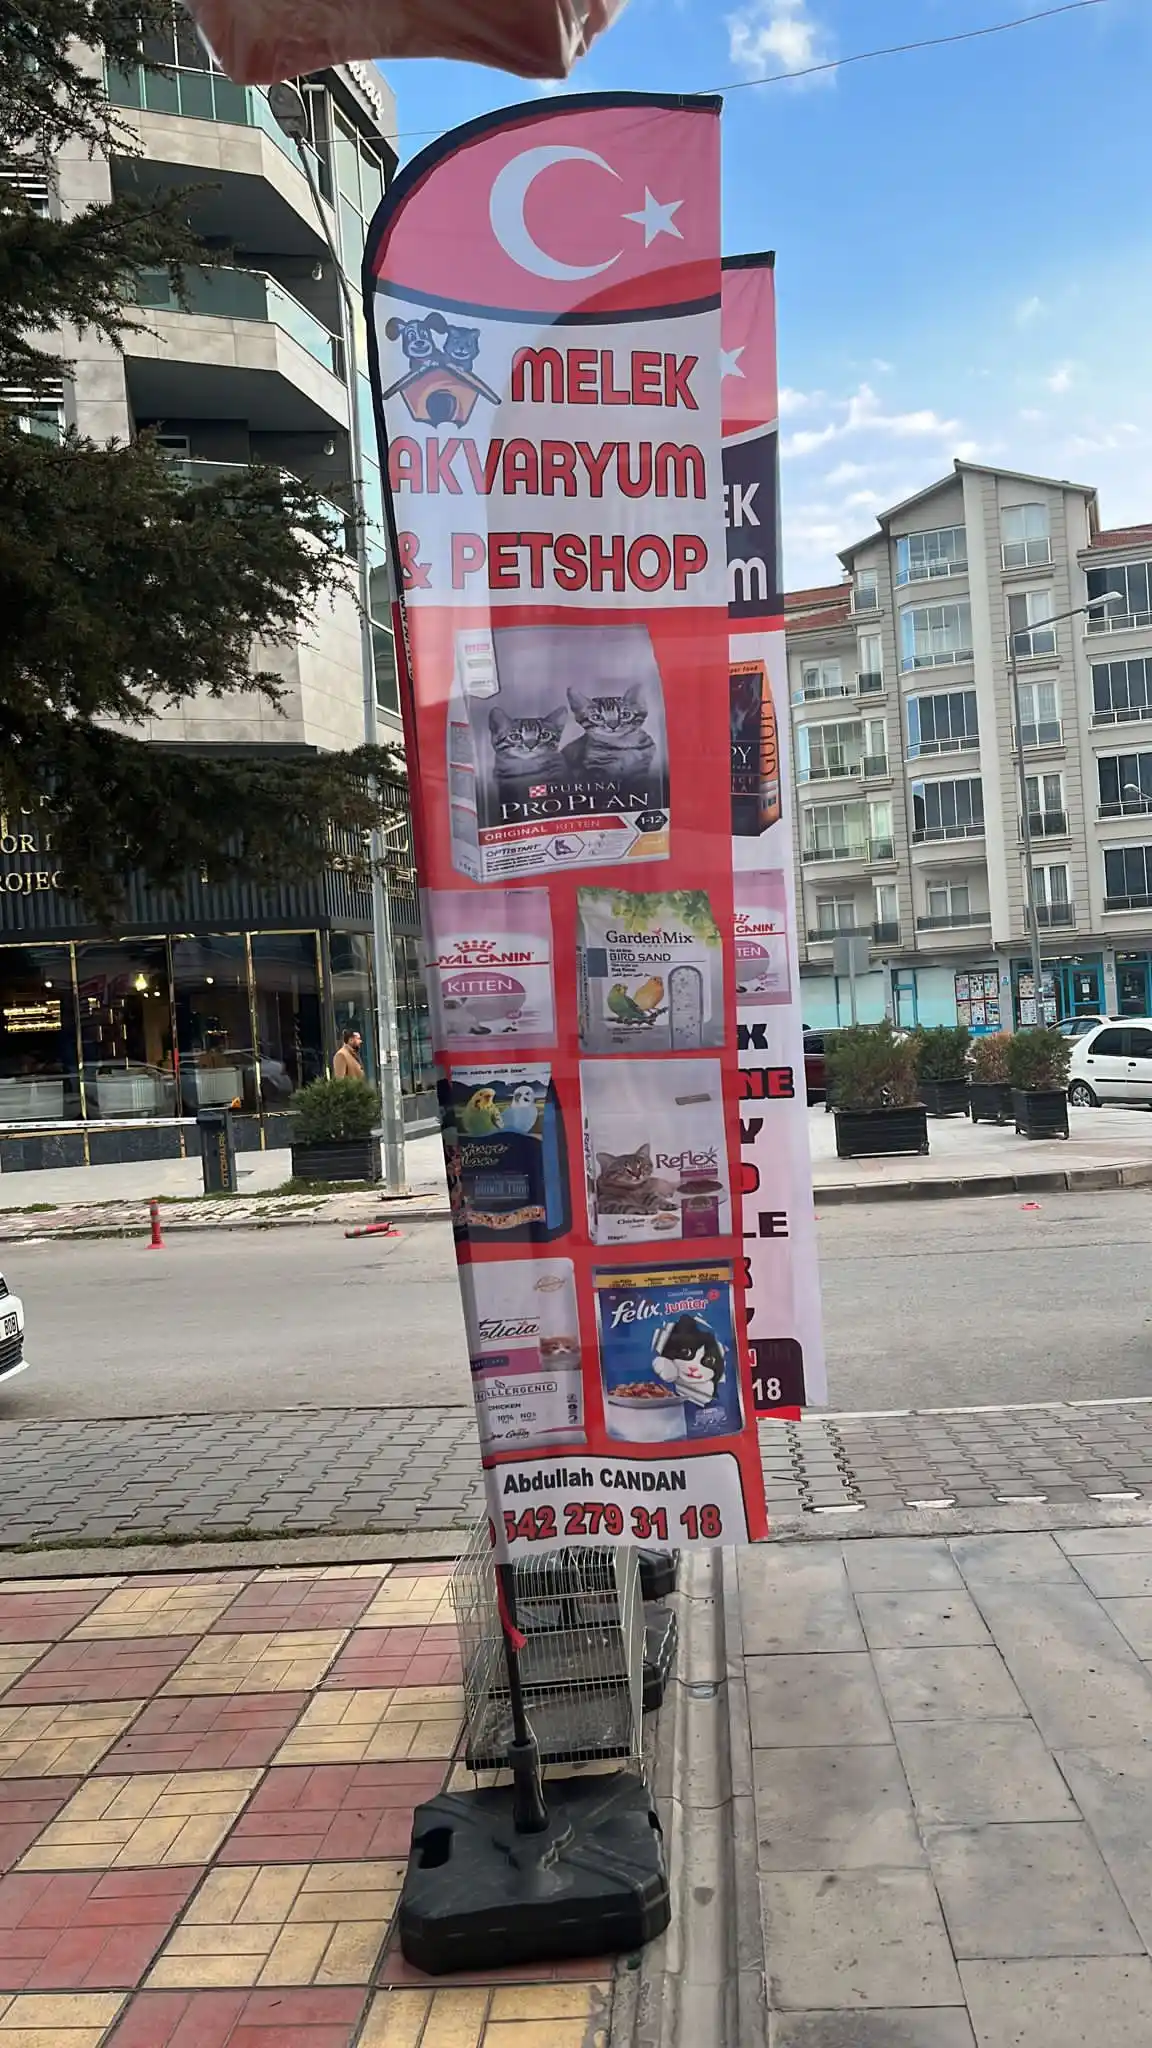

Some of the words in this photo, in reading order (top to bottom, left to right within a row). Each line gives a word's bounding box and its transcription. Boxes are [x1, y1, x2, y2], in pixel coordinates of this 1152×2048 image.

[511, 346, 700, 411] MELEK
[388, 435, 706, 500] AKVARYUM
[724, 483, 761, 528] K
[399, 532, 432, 591] &
[450, 532, 708, 592] PETSHOP
[550, 782, 617, 793] PURINA
[501, 799, 562, 820] PRO
[569, 792, 649, 811] PLAN
[484, 825, 549, 841] ORIGINAL
[555, 820, 601, 832] KITTEN
[606, 930, 661, 945] Garden
[663, 931, 694, 944] Mix
[736, 923, 774, 933] CANIN
[439, 954, 473, 964] YAL
[475, 951, 531, 963] CANIN
[609, 953, 636, 962] BIRD
[638, 952, 672, 961] SAND
[447, 979, 513, 993] KITTEN
[655, 1148, 718, 1171] Reflex
[752, 1377, 782, 1401] 18
[503, 1468, 594, 1494] Abdullah
[600, 1468, 687, 1491] CANDAN
[487, 1505, 558, 1548] 542
[563, 1502, 624, 1536] 279
[630, 1506, 669, 1540] 31
[680, 1503, 722, 1540] 18
